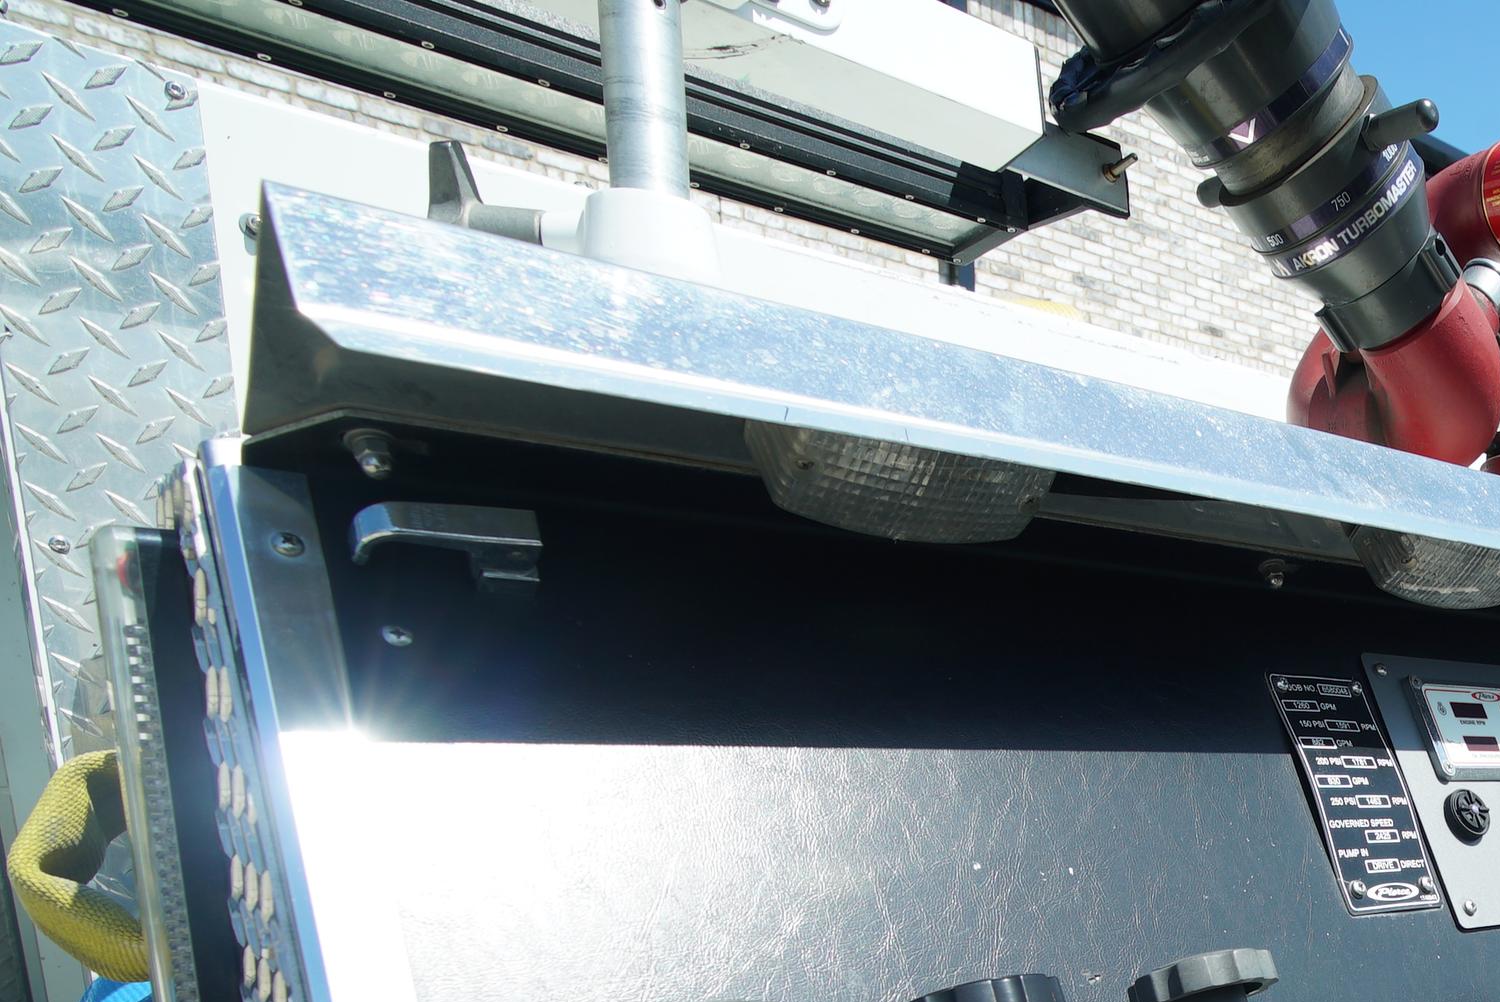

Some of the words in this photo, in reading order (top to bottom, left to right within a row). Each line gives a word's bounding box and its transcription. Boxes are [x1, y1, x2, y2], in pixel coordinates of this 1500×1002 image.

[1330, 191, 1351, 212] 750
[1293, 238, 1340, 272] AKRON
[1337, 159, 1418, 246] TURBOMASTER
[1266, 232, 1284, 248] 500
[1320, 702, 1337, 711] GPM
[1336, 740, 1353, 748] GPM
[1352, 777, 1370, 786] GPM
[1328, 819, 1370, 829] GOVERNED
[1370, 818, 1394, 828] SPEED
[1401, 830, 1418, 840] RPM
[1337, 848, 1359, 859] PUMP
[1359, 847, 1369, 857] IN
[1372, 860, 1395, 871] DRIVE
[1400, 859, 1425, 869] DIRECT
